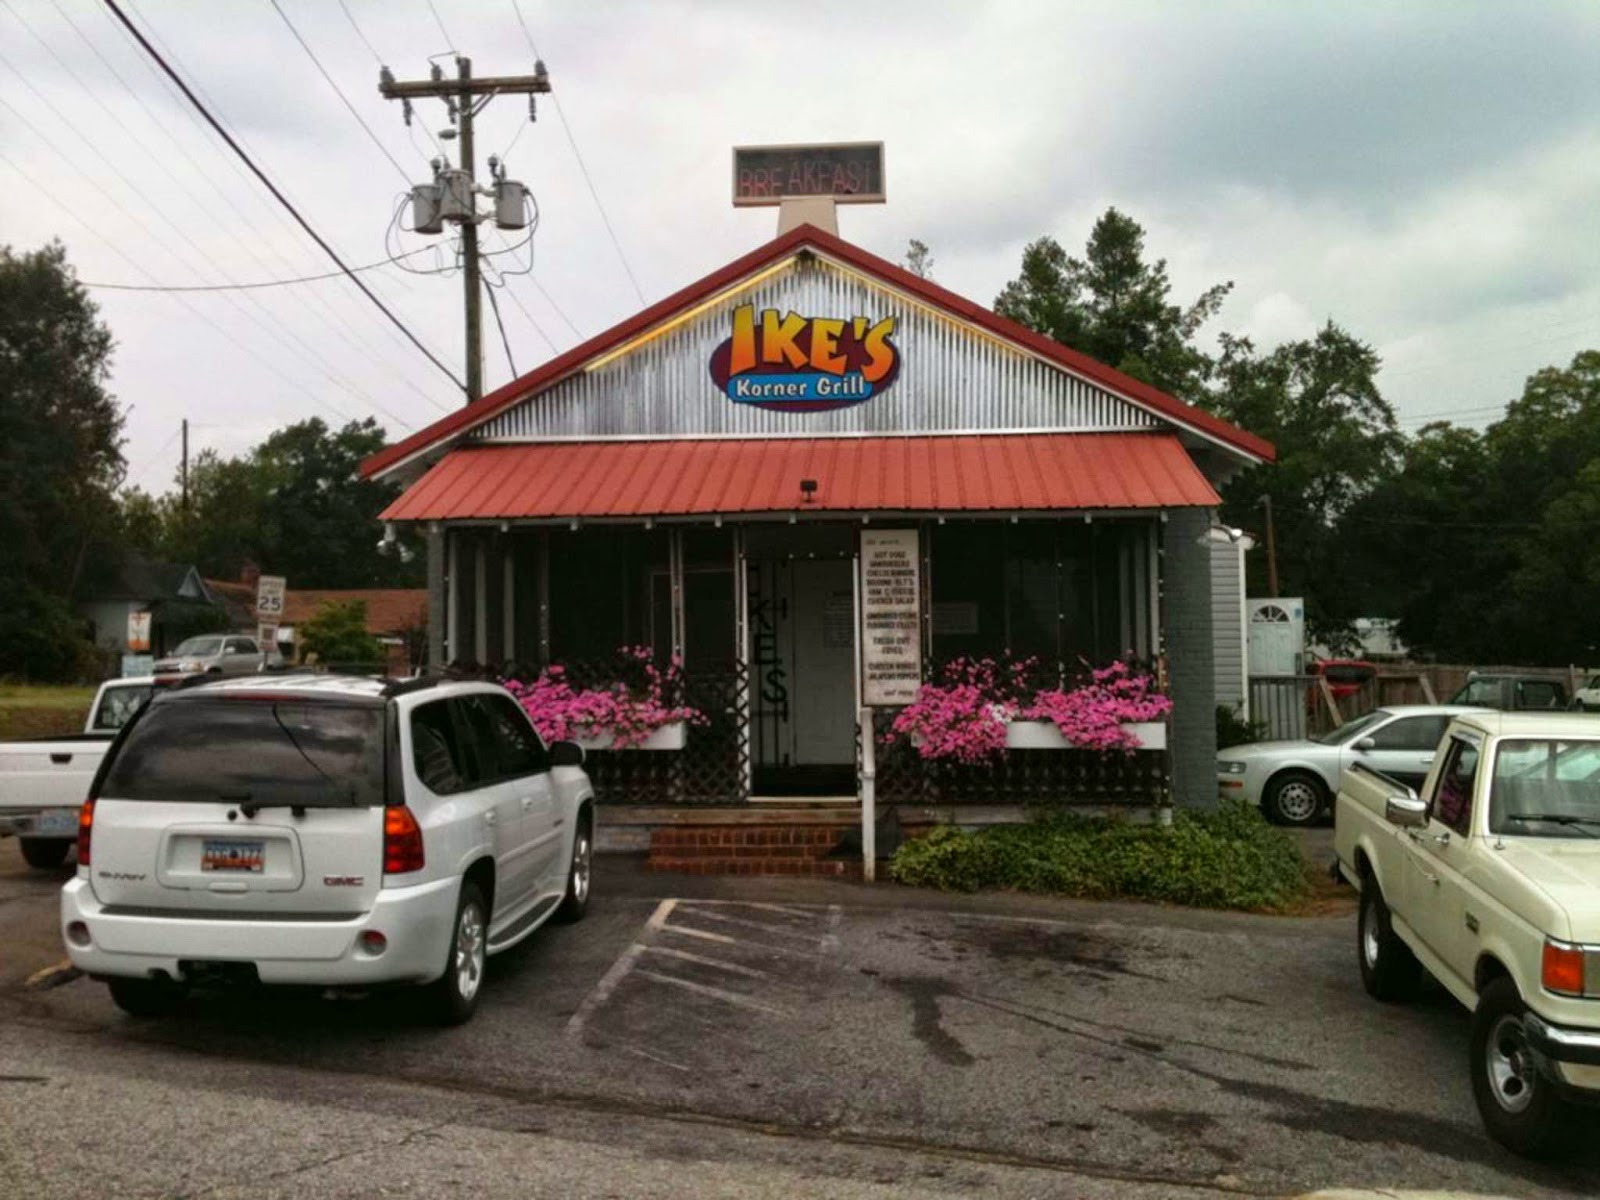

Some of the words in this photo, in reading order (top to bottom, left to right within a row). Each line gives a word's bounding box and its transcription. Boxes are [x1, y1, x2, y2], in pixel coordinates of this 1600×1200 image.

[738, 159, 873, 198] BREAKFAST
[730, 302, 895, 382] IKE'S
[736, 379, 807, 397] Korner
[816, 375, 865, 396] Grill
[259, 596, 281, 611] 25
[323, 876, 363, 887] GMC
